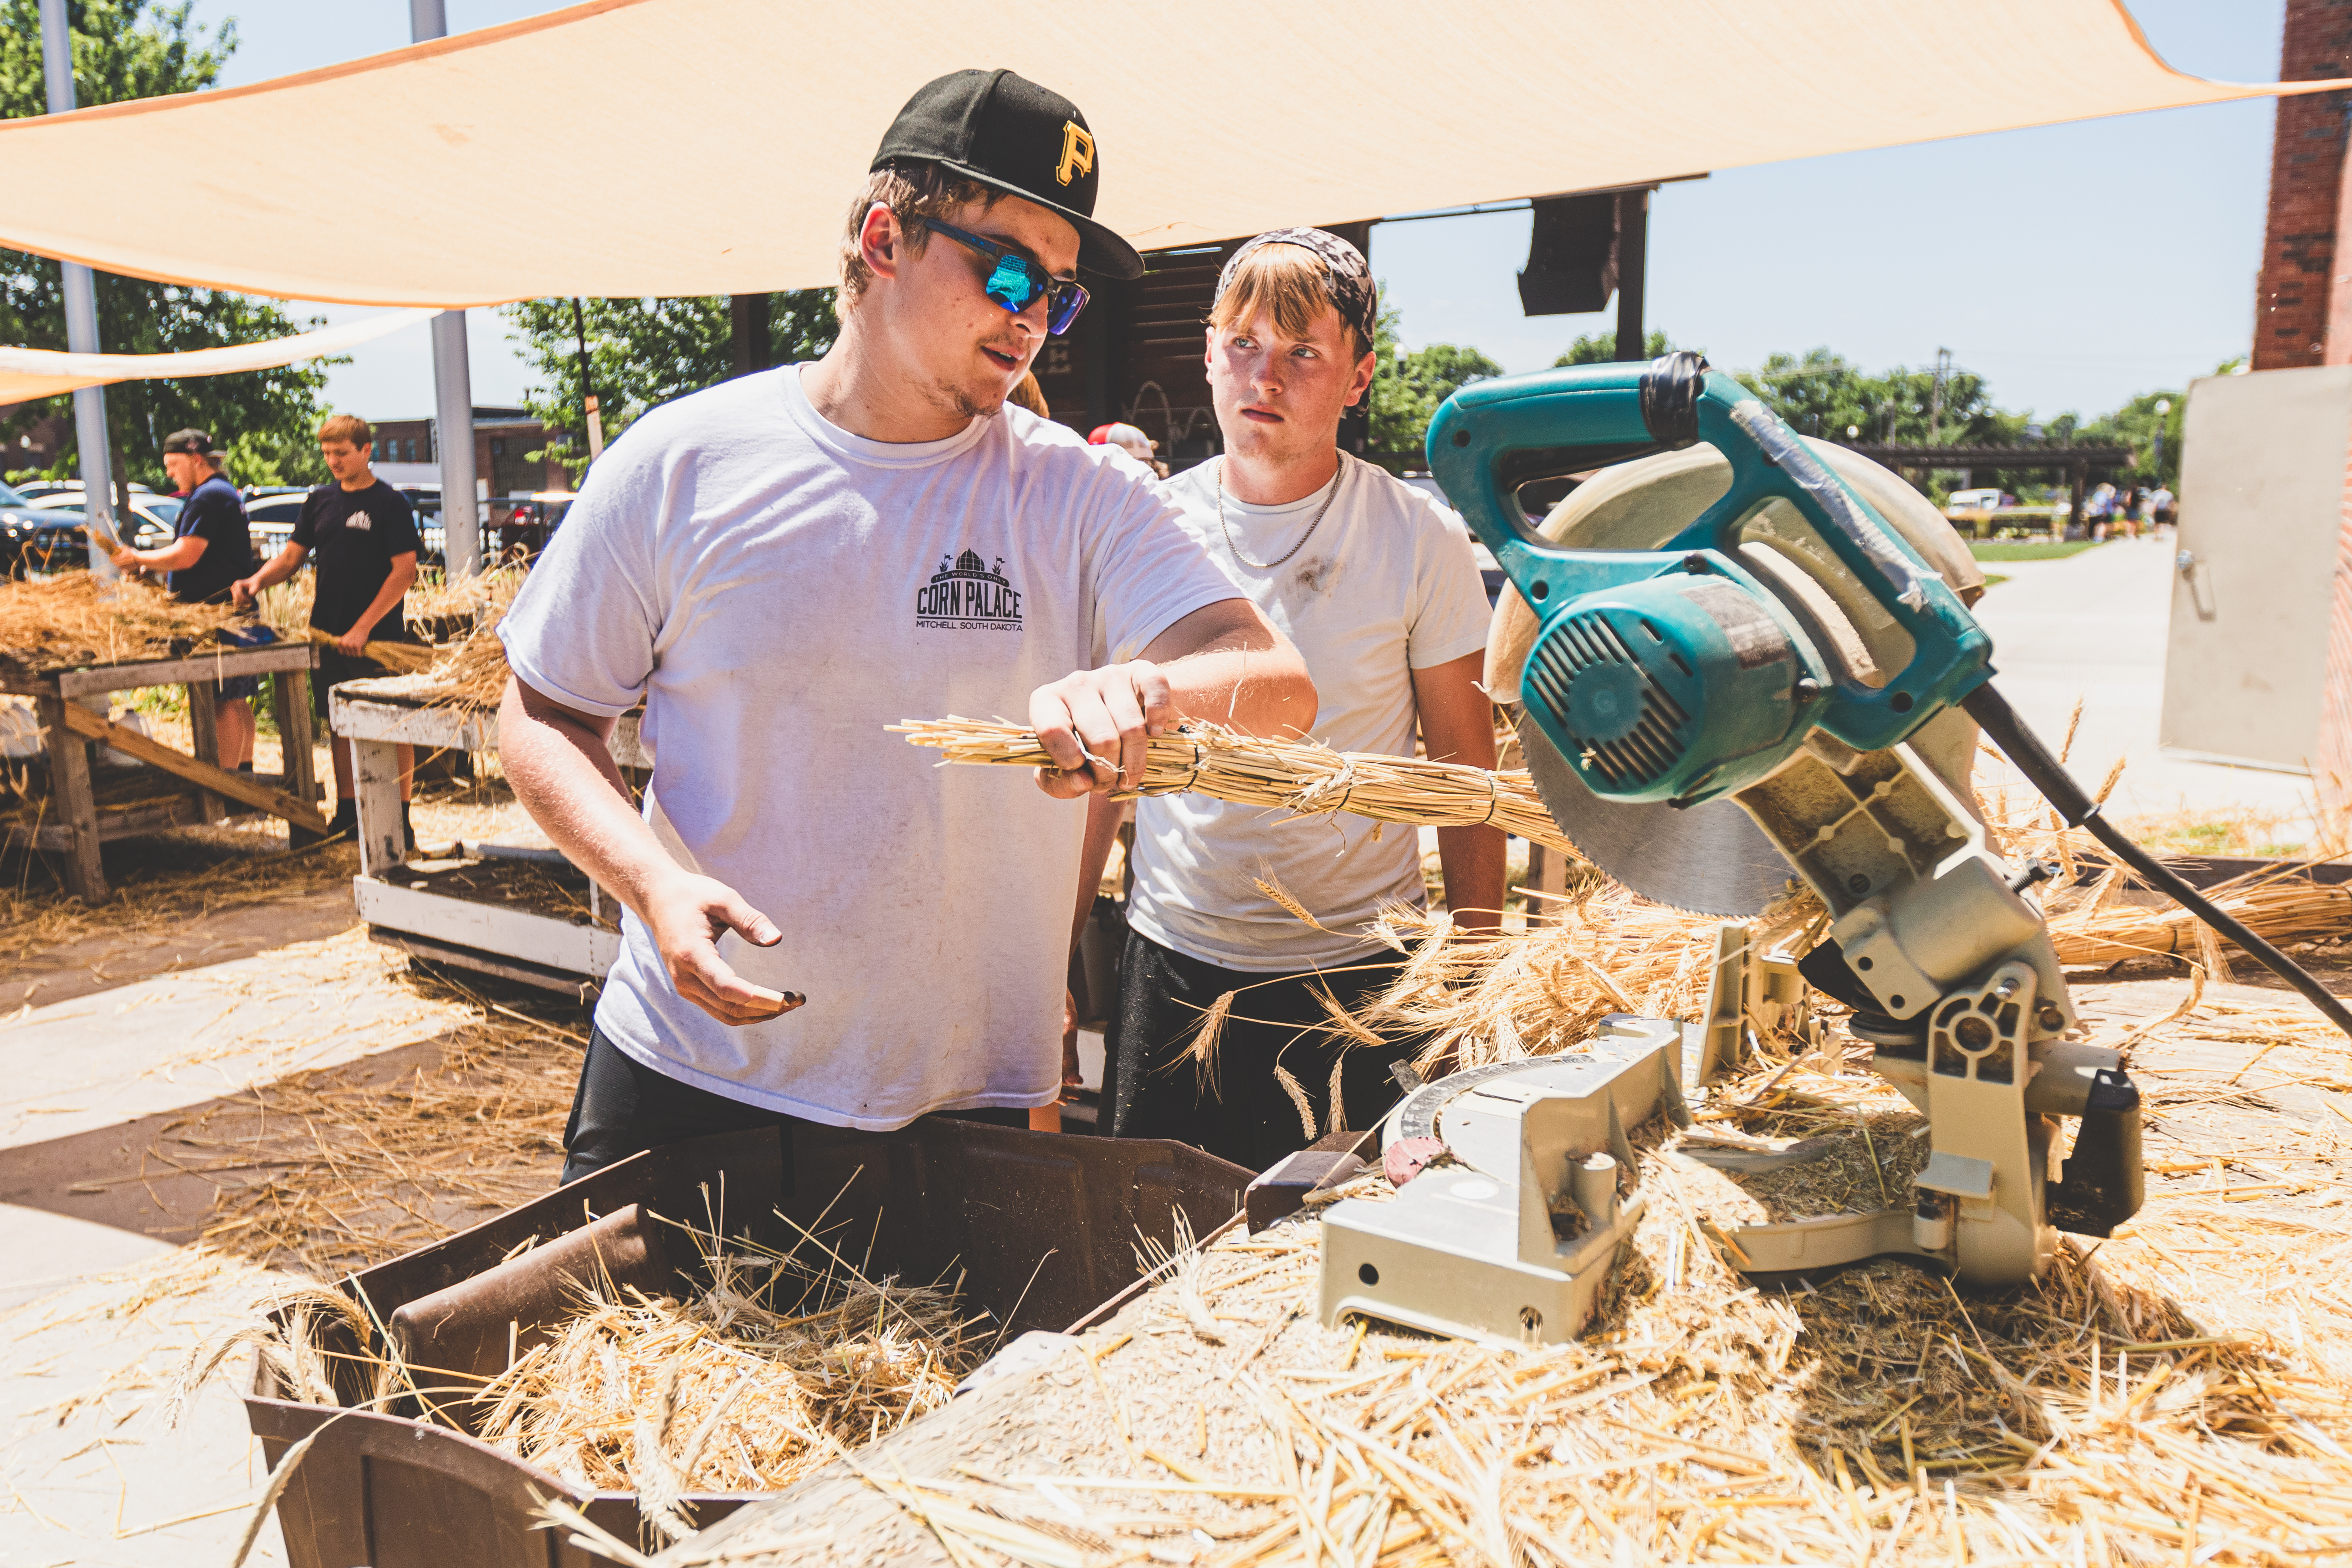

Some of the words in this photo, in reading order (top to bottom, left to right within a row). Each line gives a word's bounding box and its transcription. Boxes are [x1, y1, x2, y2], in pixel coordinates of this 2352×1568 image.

[1056, 120, 1095, 186] P
[987, 574, 1006, 584] ONLY
[917, 580, 960, 616] CORN
[965, 581, 1022, 619] PALACE
[990, 623, 1023, 631] DAKOTA
